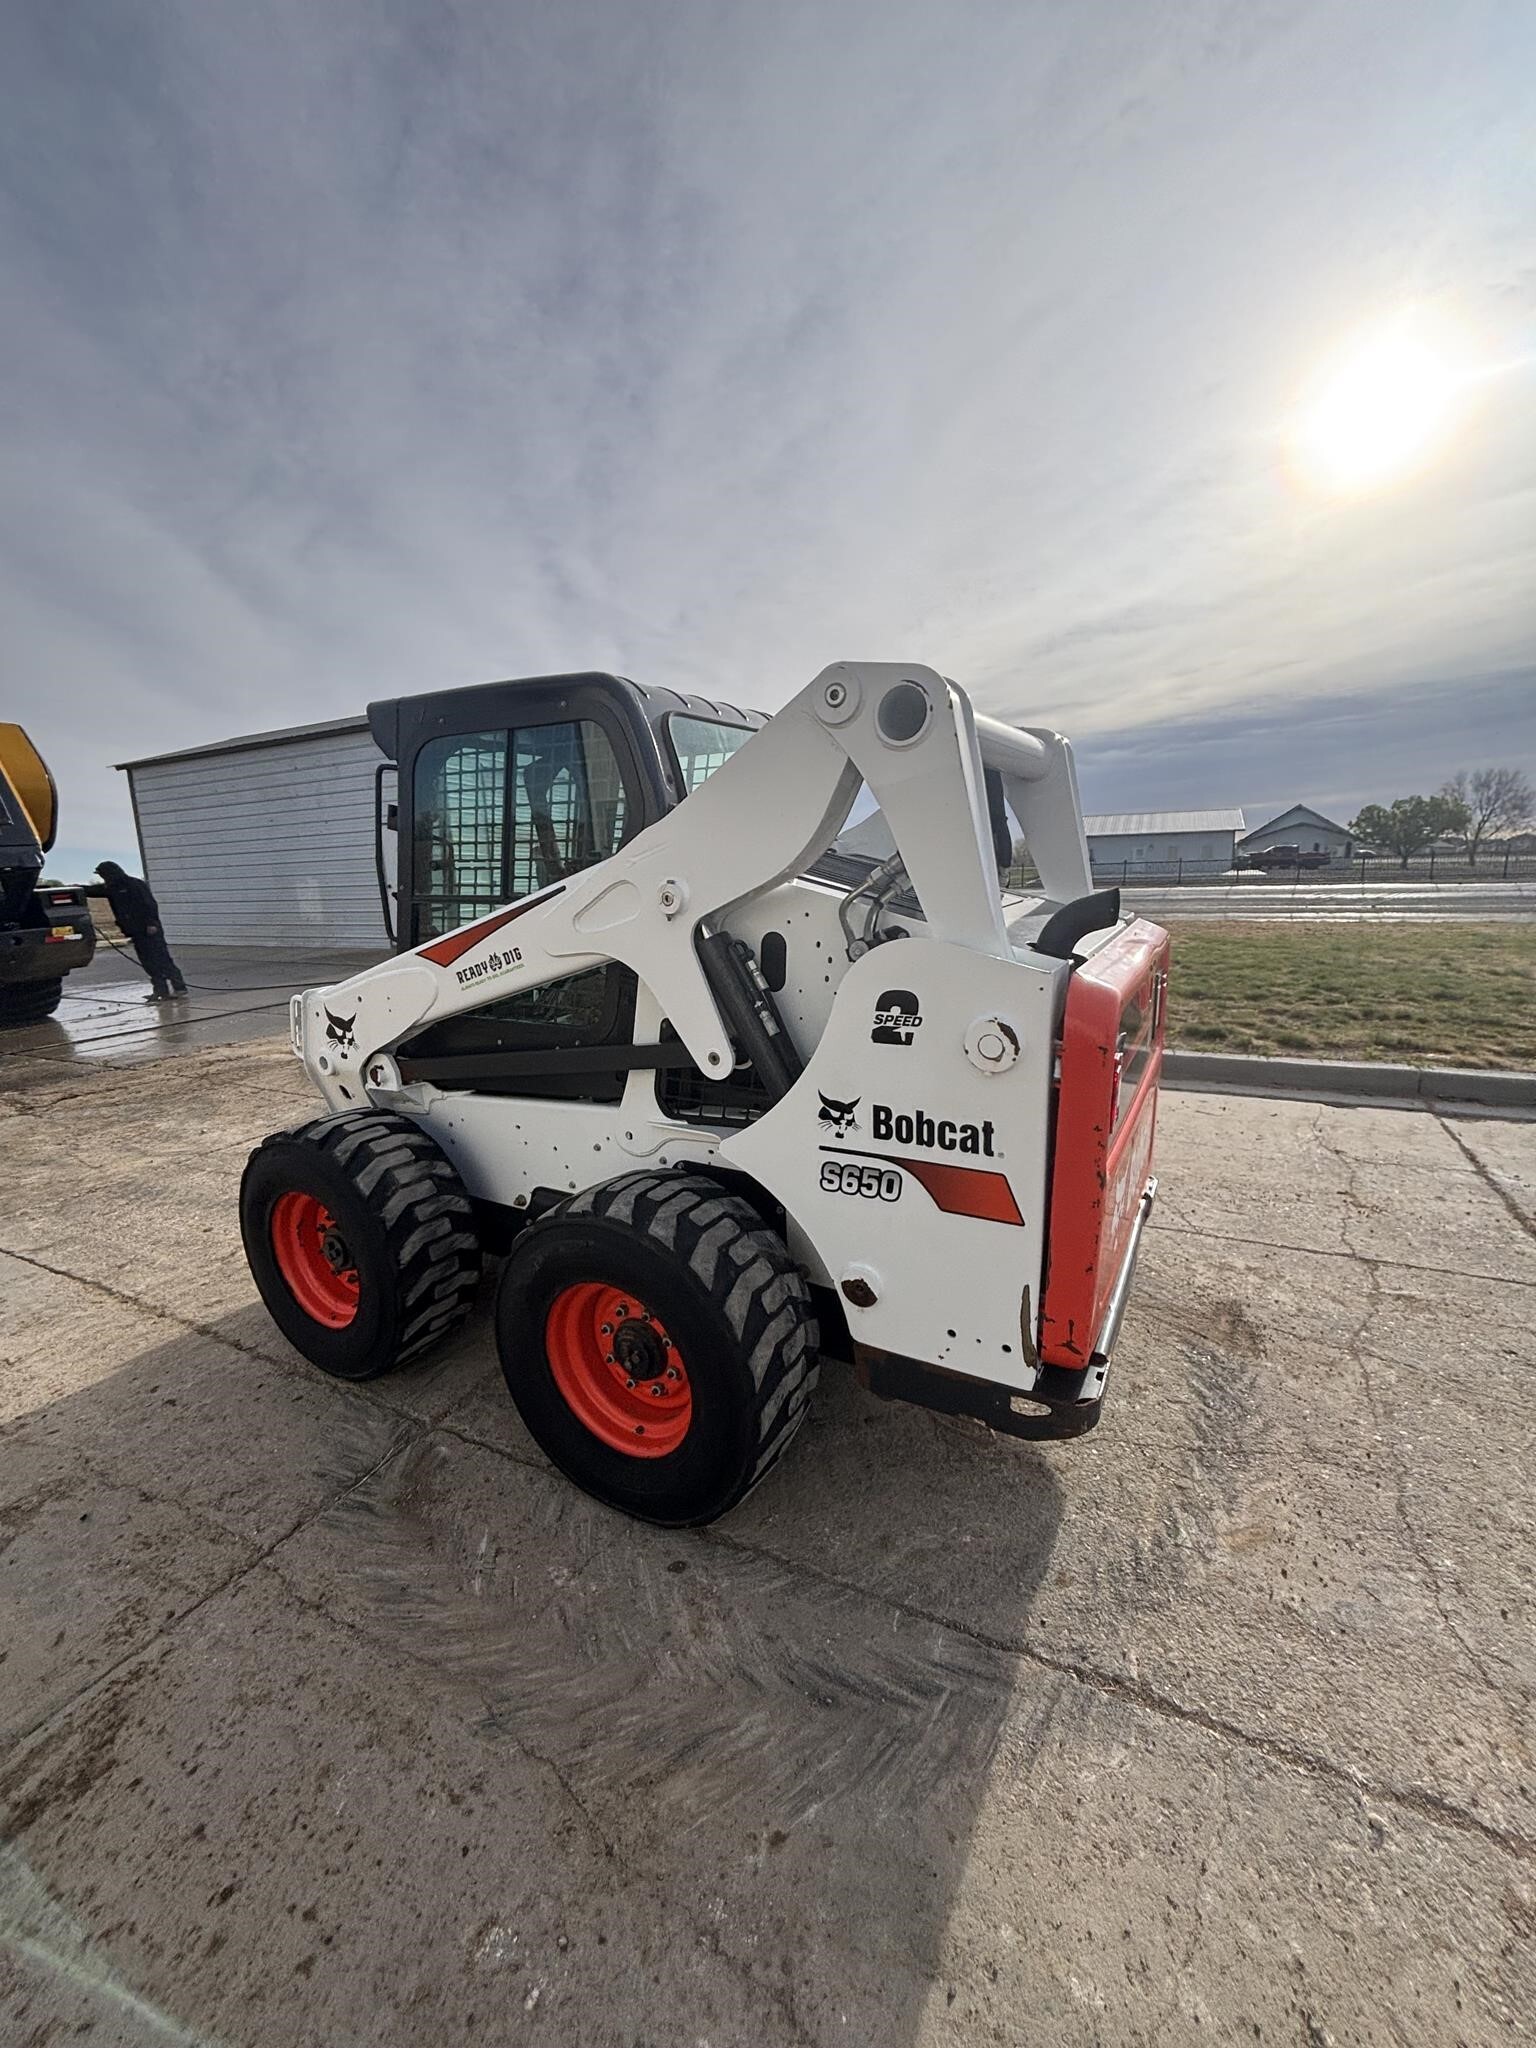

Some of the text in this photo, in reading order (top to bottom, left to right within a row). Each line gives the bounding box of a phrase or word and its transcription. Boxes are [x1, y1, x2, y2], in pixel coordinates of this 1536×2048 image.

[456, 961, 488, 984] READY
[502, 947, 523, 965] DIG
[873, 1013, 923, 1027] SPEED
[872, 1104, 995, 1157] Bobcat
[819, 1161, 903, 1202] S650
